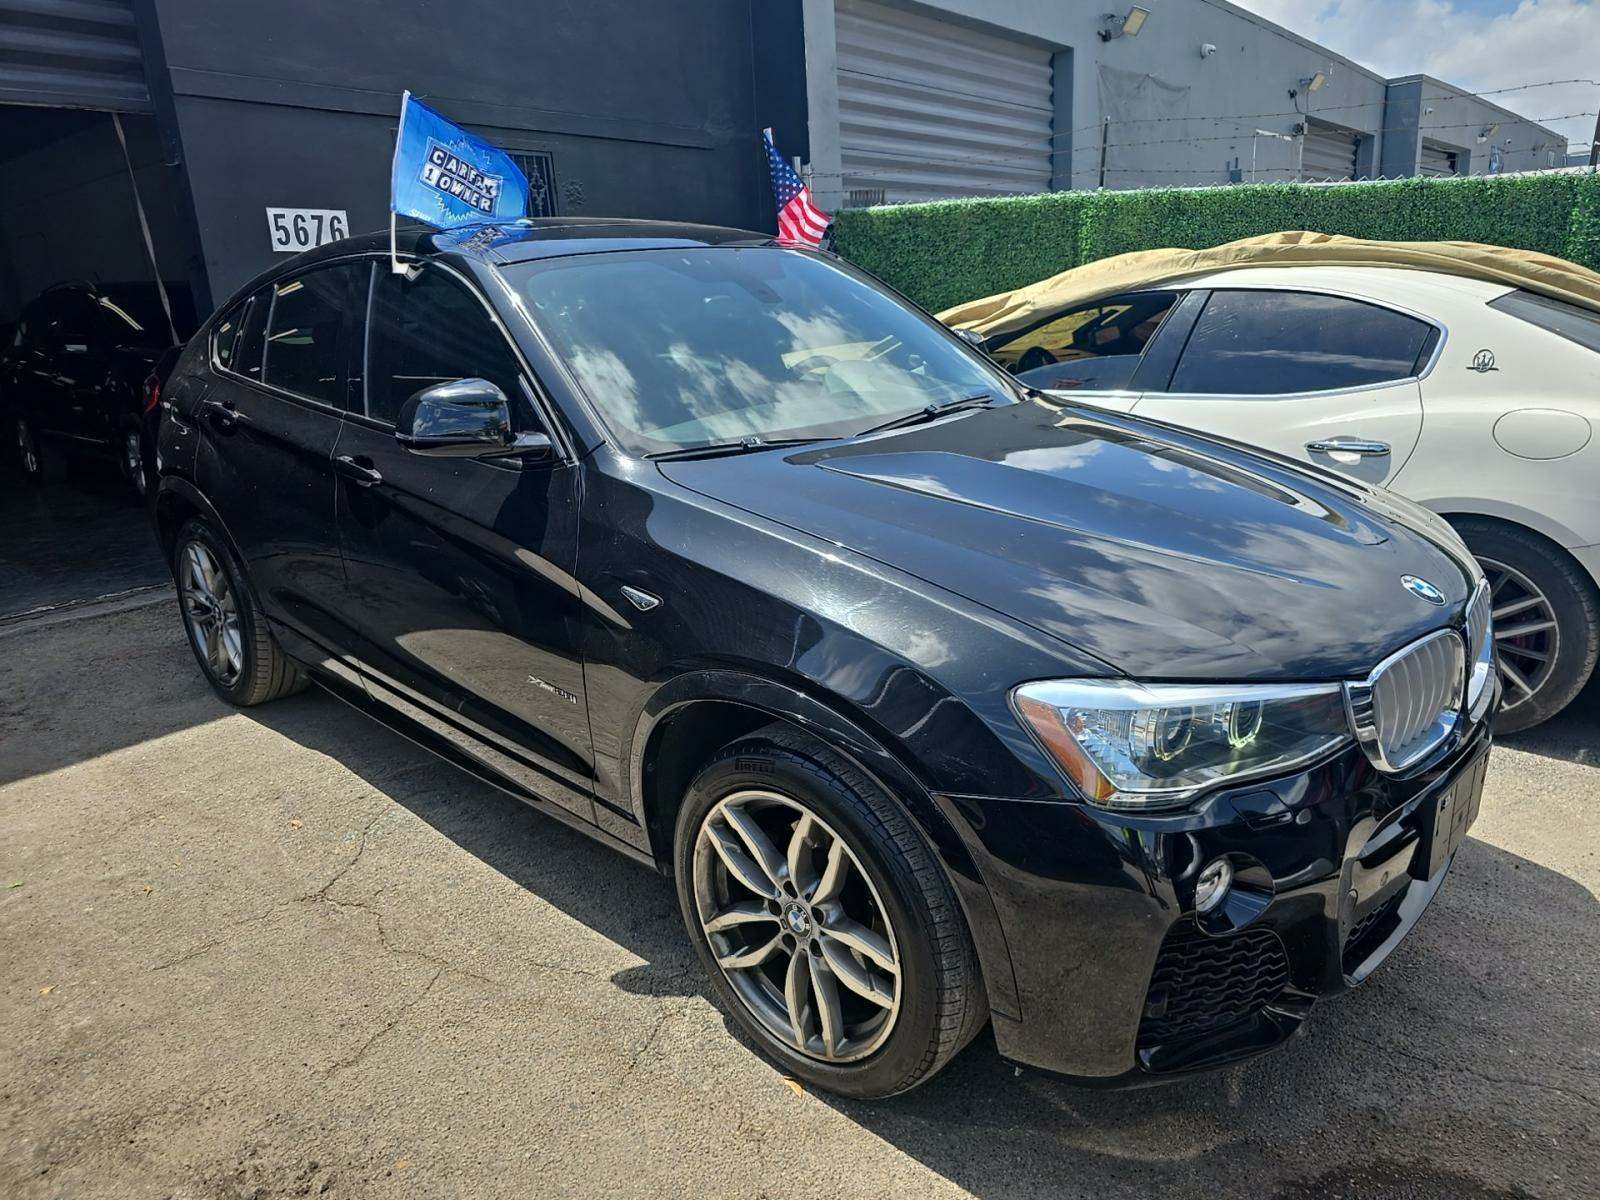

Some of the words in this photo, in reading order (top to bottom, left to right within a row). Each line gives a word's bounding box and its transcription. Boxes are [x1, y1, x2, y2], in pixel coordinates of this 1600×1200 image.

[432, 150, 494, 196] CARFAX
[439, 176, 491, 211] OWNER
[273, 213, 345, 247] 5676
